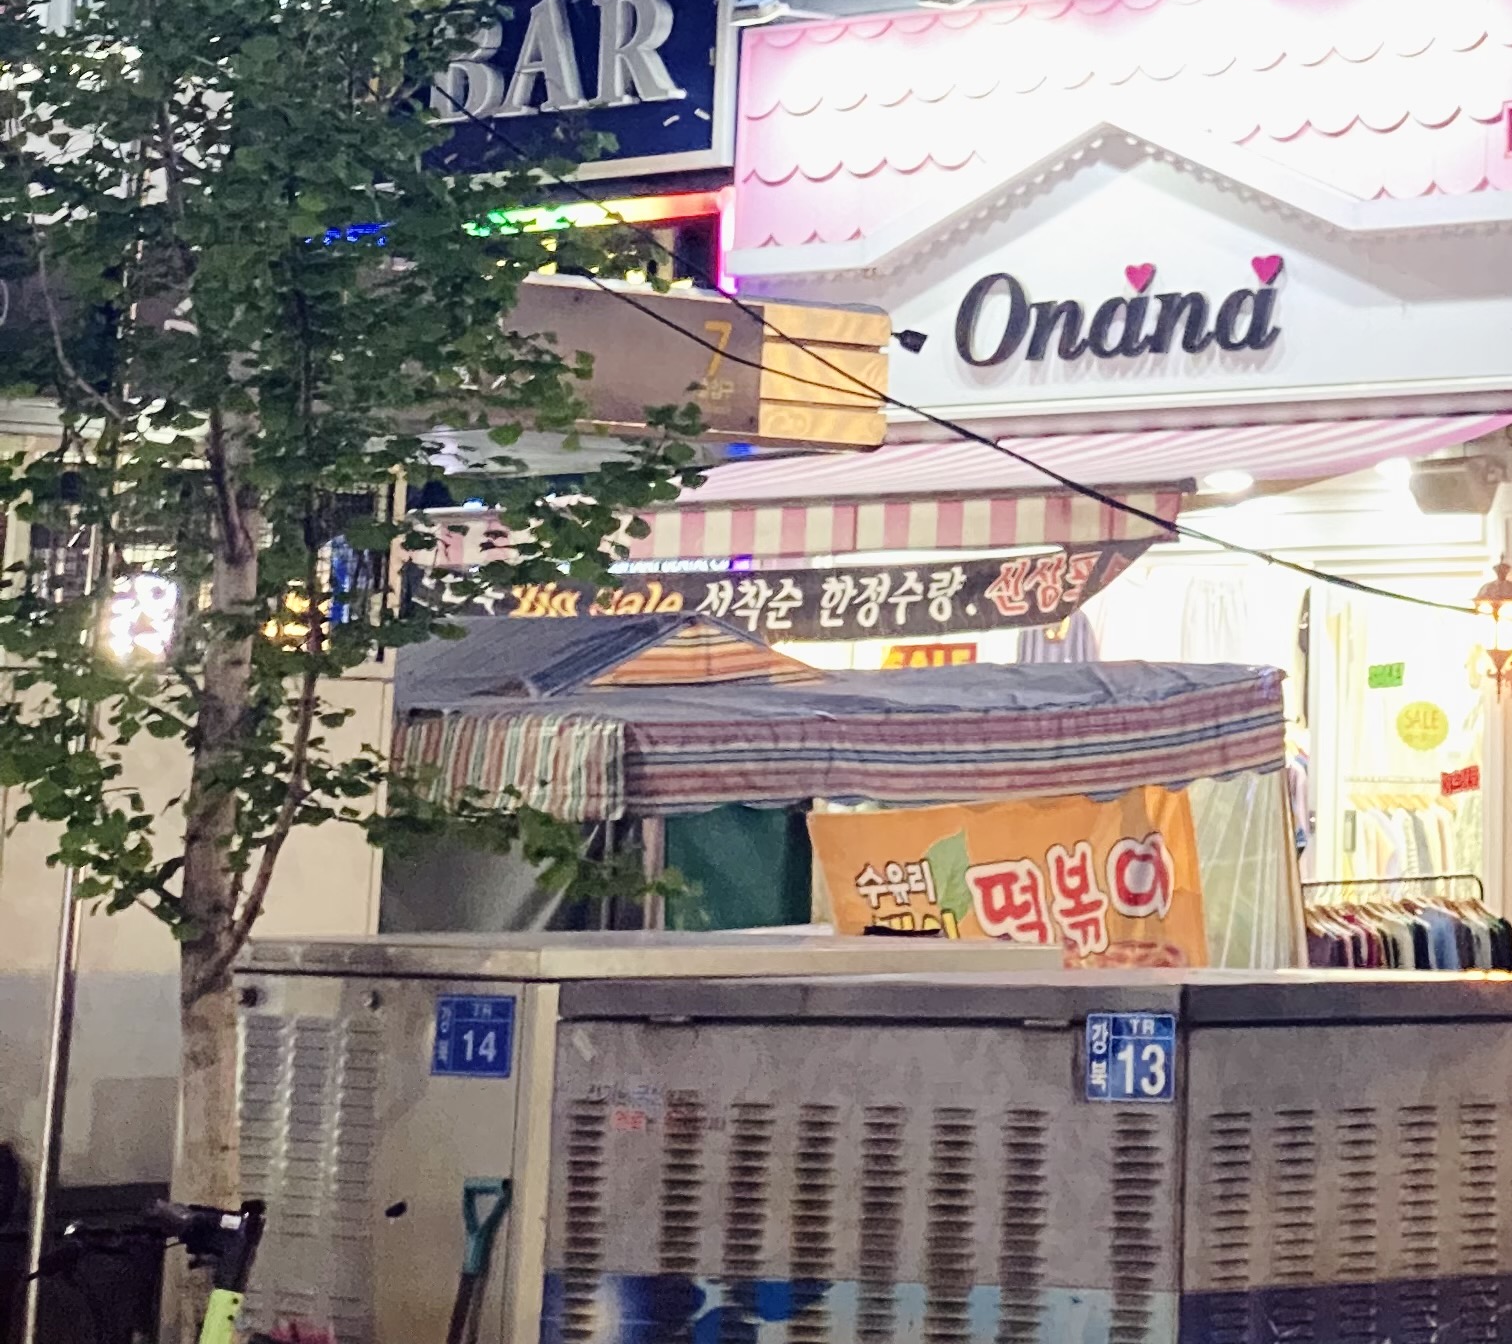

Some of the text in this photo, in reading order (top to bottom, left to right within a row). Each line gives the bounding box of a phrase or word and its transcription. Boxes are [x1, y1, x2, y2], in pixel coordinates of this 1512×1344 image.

[955, 264, 1283, 367] Onana
[855, 859, 937, 909] 수유리
[463, 1029, 497, 1063] 14
[1129, 1018, 1155, 1035] TR
[1090, 1020, 1108, 1092] 강북
[1117, 1043, 1166, 1095] 13
